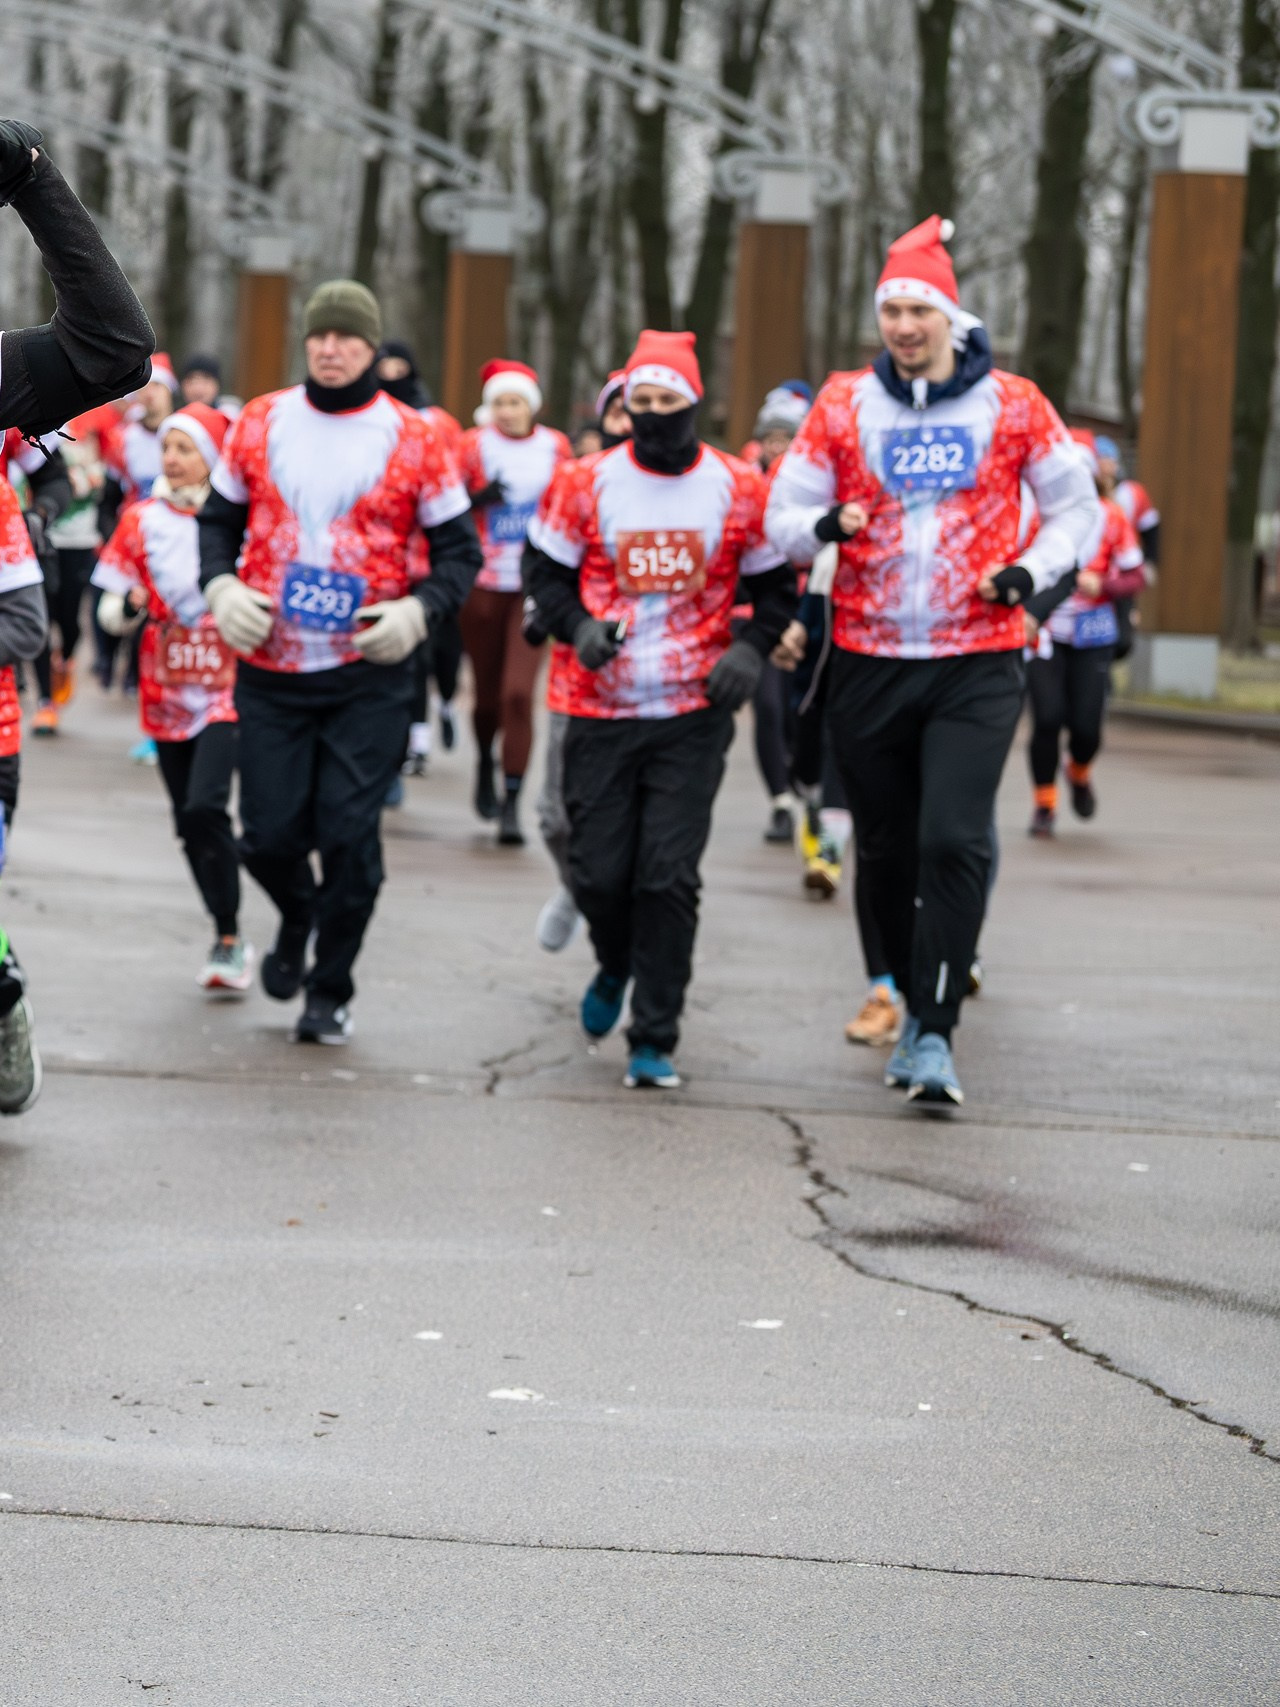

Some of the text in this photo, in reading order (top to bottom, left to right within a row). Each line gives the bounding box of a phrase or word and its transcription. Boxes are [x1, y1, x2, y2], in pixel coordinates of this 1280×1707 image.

[892, 442, 965, 475] 2282
[628, 546, 695, 577] 5154
[288, 580, 354, 619] 2293
[167, 642, 222, 672] 5114
